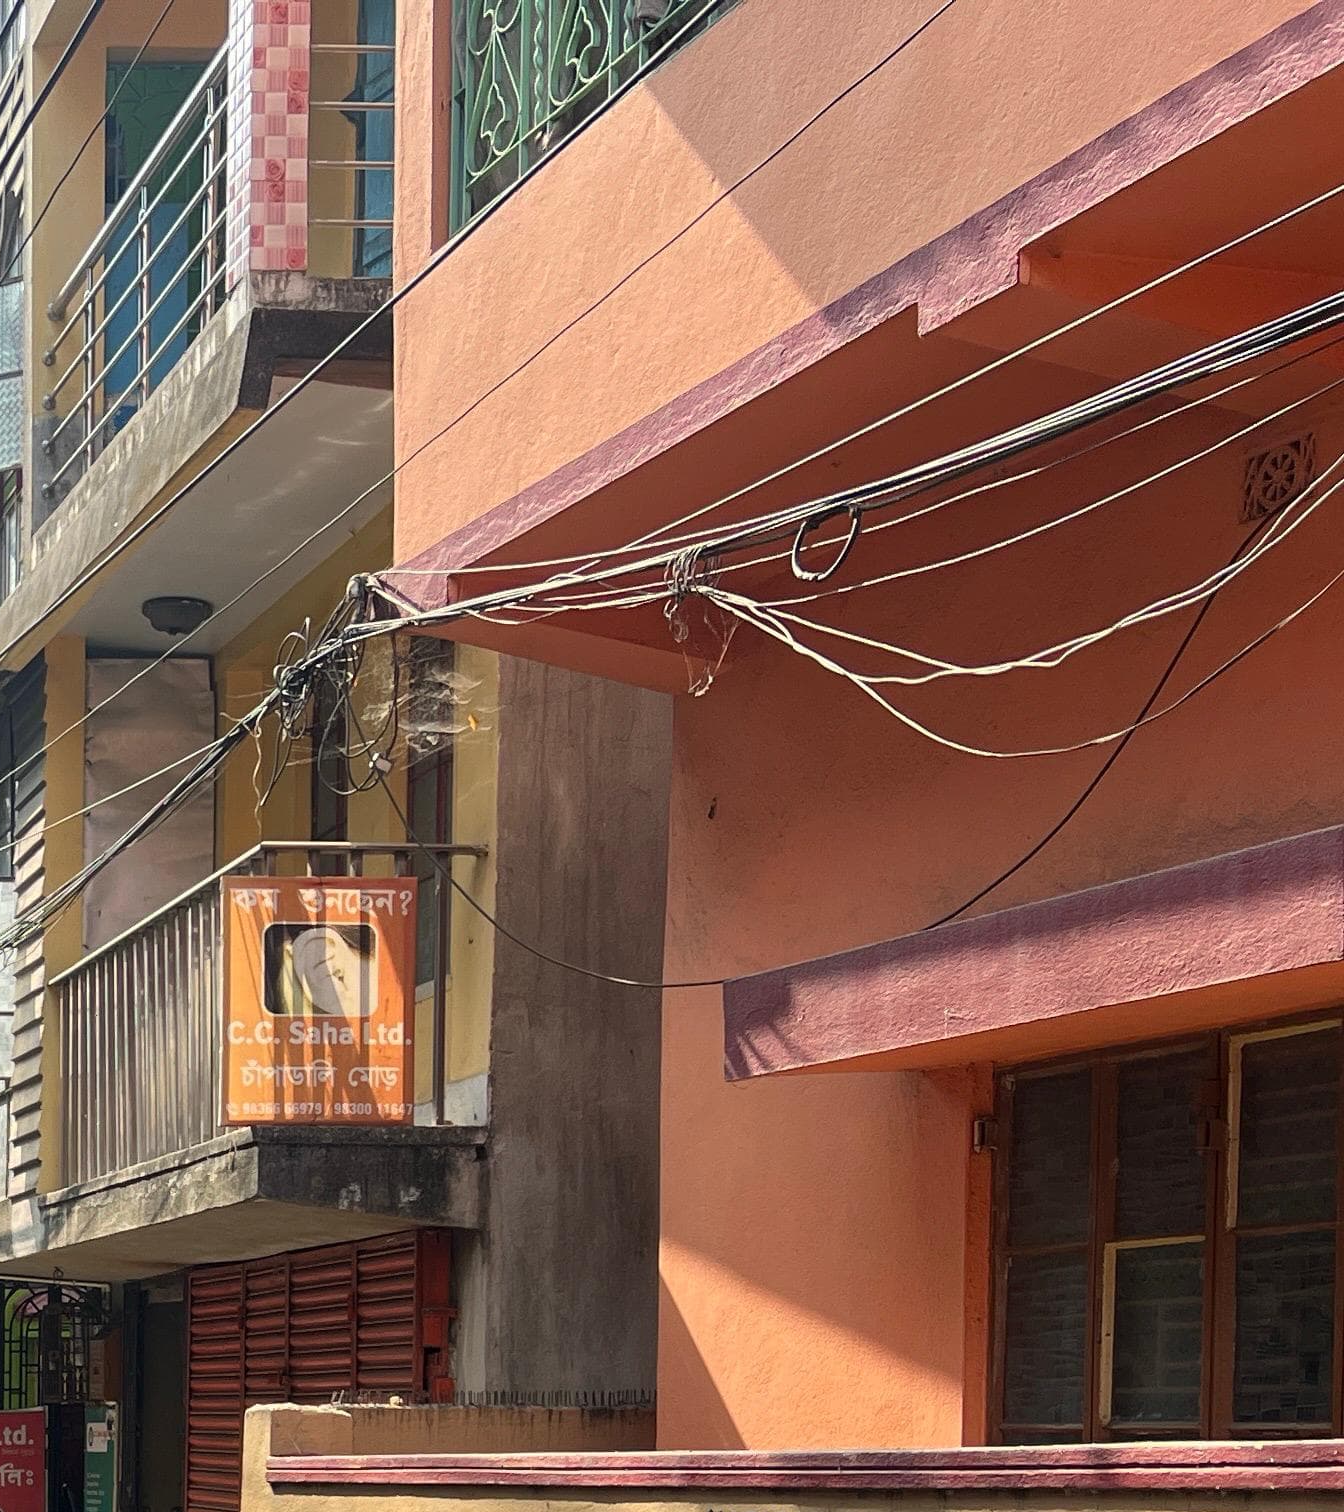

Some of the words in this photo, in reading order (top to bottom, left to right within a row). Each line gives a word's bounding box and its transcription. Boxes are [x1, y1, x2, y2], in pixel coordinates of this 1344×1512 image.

[233, 887, 280, 914] কম
[227, 1020, 281, 1045] C.C.
[288, 1020, 354, 1045] Saha
[363, 1021, 412, 1046] Ltd.
[284, 1102, 323, 1116] 66979
